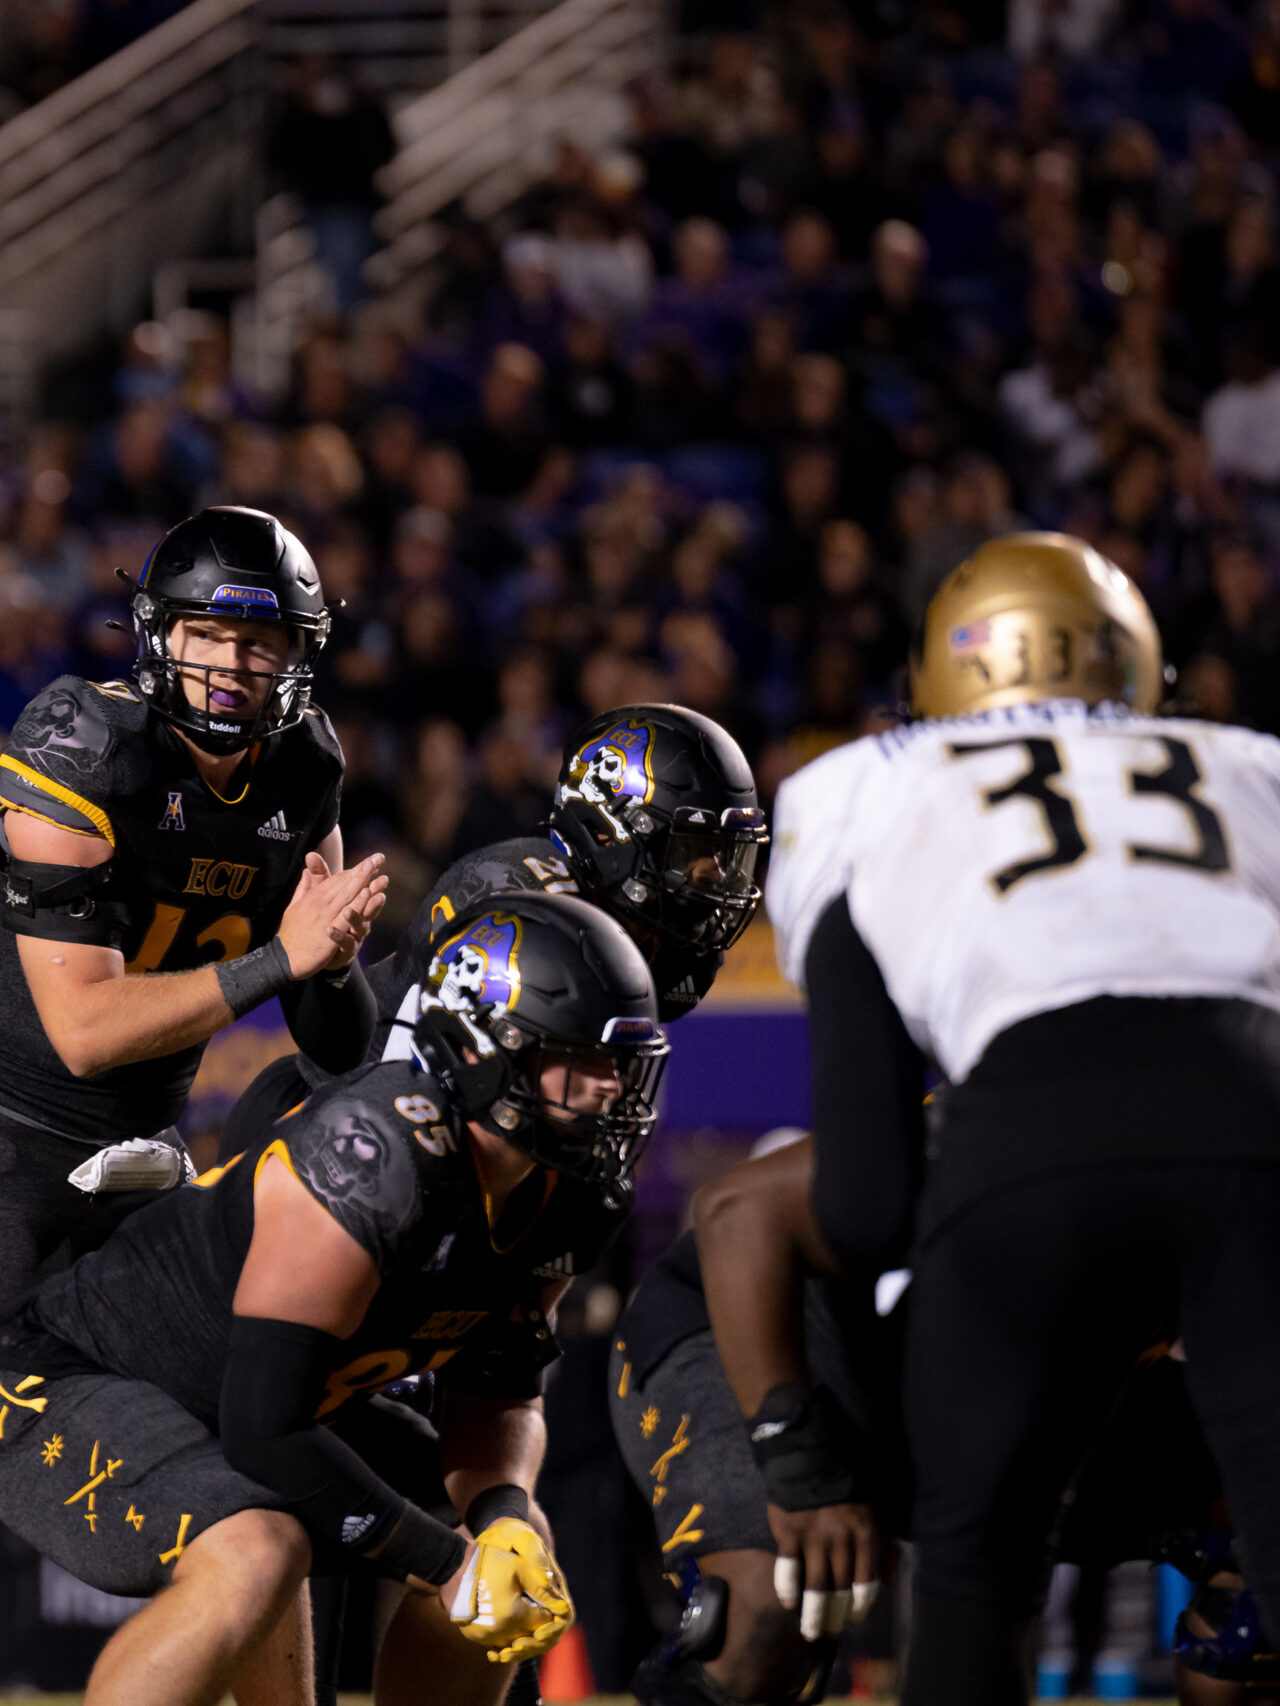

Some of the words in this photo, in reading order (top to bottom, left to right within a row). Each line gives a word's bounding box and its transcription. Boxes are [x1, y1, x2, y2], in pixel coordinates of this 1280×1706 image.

[223, 587, 270, 602] PIRATES
[609, 730, 641, 748] ECU
[943, 734, 1234, 895] 33
[257, 825, 290, 842] adidas
[182, 857, 261, 900] ECU
[470, 926, 506, 947] ECU
[393, 1094, 459, 1158] 85
[408, 1309, 492, 1341] ECU
